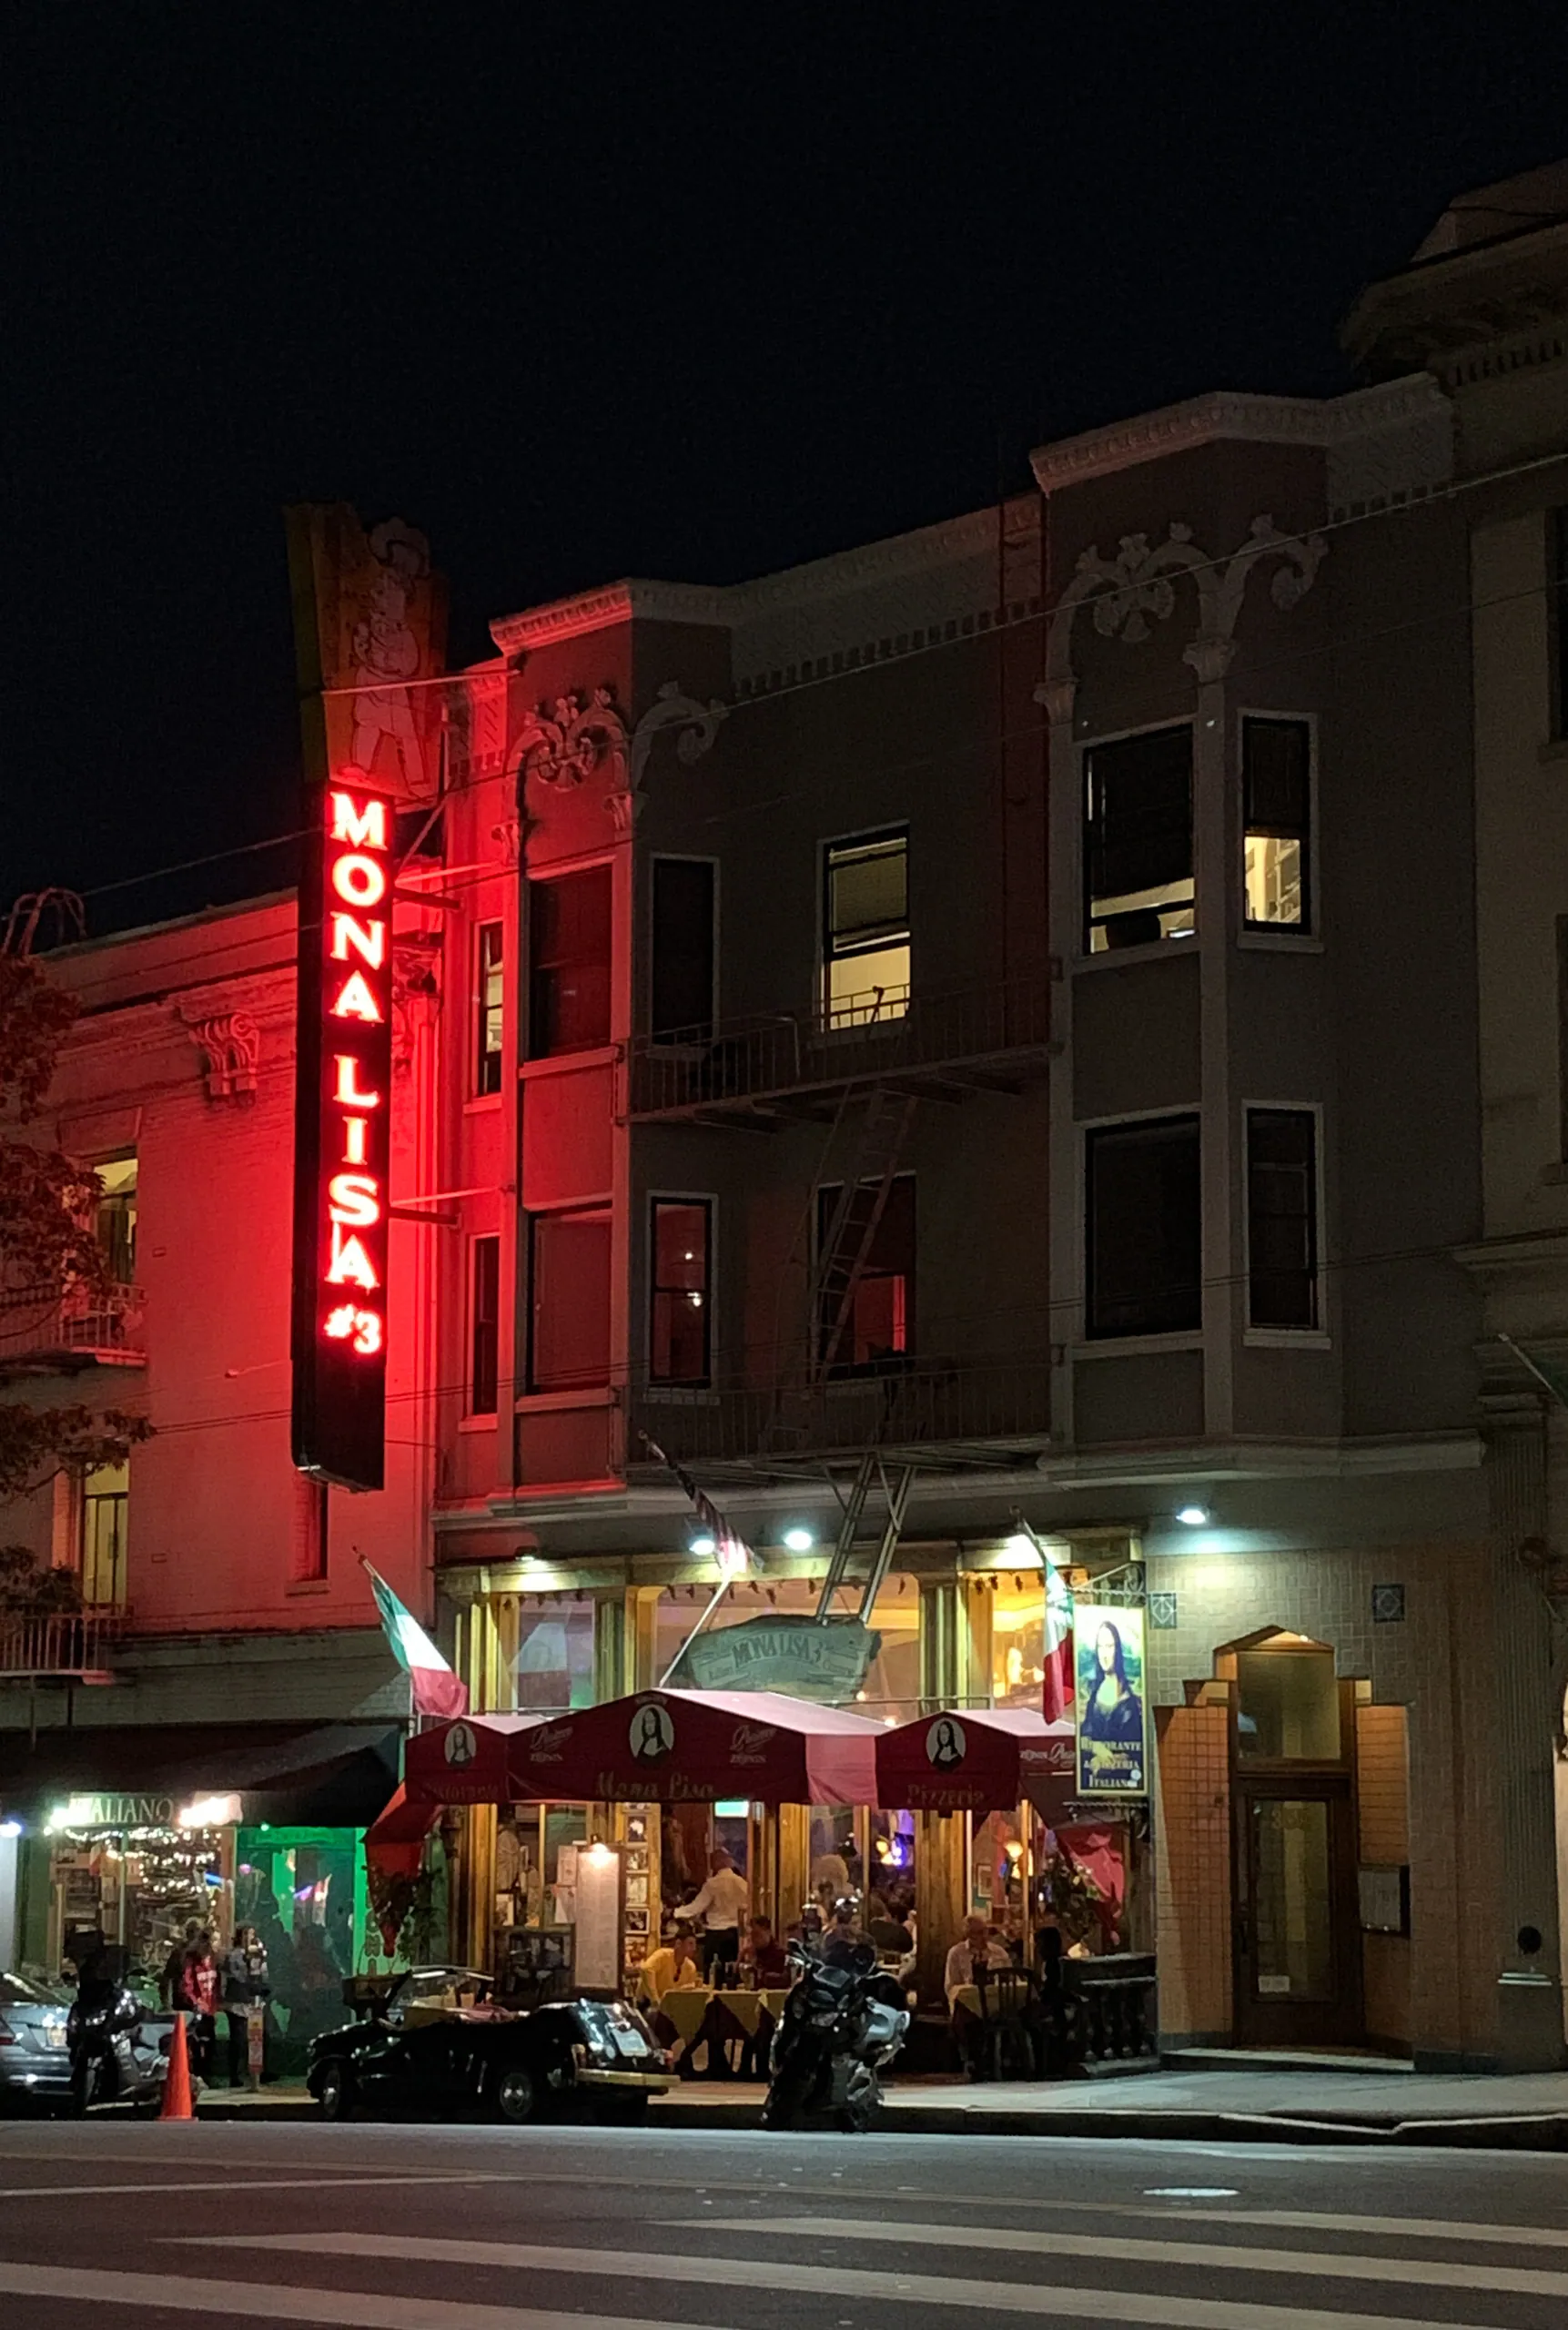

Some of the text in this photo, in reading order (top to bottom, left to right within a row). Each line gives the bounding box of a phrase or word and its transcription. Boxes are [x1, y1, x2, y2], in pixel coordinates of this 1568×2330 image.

[324, 790, 389, 1354] MONA LISA #3
[1081, 1737, 1142, 1751] RIORANTE
[595, 1770, 660, 1799] Mona
[1088, 1774, 1138, 1788] ITALIAN
[906, 1783, 985, 1807] Pizzeria
[70, 1797, 175, 1824] ALIANO
